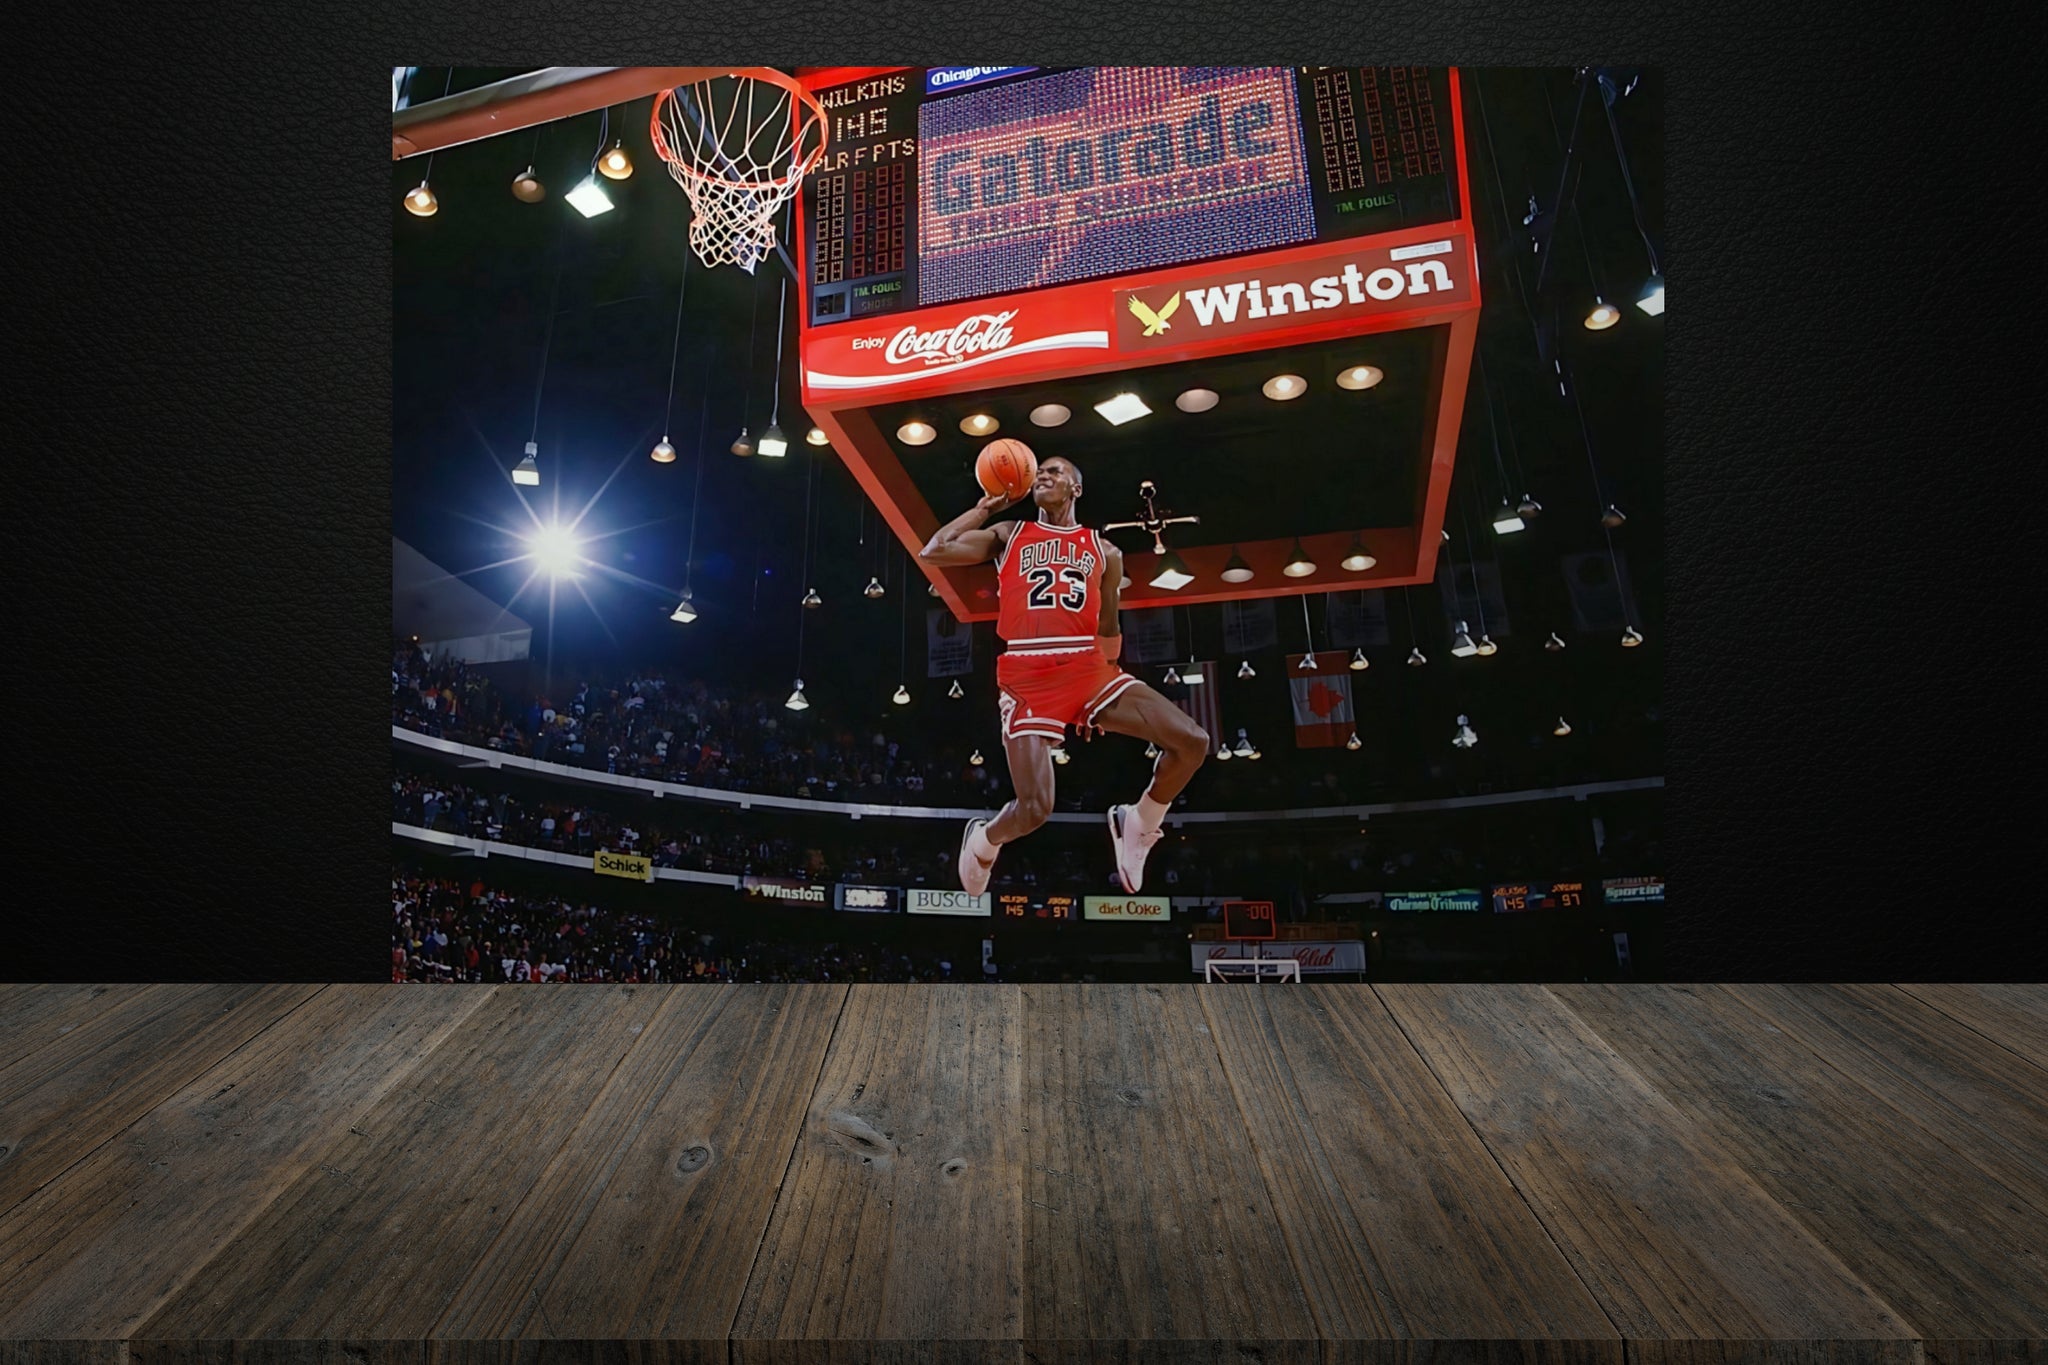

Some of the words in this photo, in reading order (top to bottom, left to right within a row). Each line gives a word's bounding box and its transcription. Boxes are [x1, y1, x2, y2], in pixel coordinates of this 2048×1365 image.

[931, 67, 980, 86] Chicago
[820, 76, 905, 109] WILKINS
[873, 138, 915, 163] PTS
[931, 92, 1277, 217] Gatorade
[1358, 194, 1396, 210] FOULS
[871, 281, 902, 296] FOULS
[1186, 260, 1454, 327] Winston
[852, 336, 886, 350] Enjoy
[885, 309, 1019, 364] Coca-Cola
[1020, 538, 1095, 577] BULLS
[1027, 567, 1087, 612] 23
[599, 855, 645, 874] Schick
[761, 884, 825, 902] Winston
[917, 891, 981, 909] BUSCH
[1561, 893, 1581, 906] 97
[1005, 904, 1024, 916] 145
[1053, 906, 1069, 918] 97
[1099, 903, 1122, 915] diet
[1126, 901, 1162, 916] Coke
